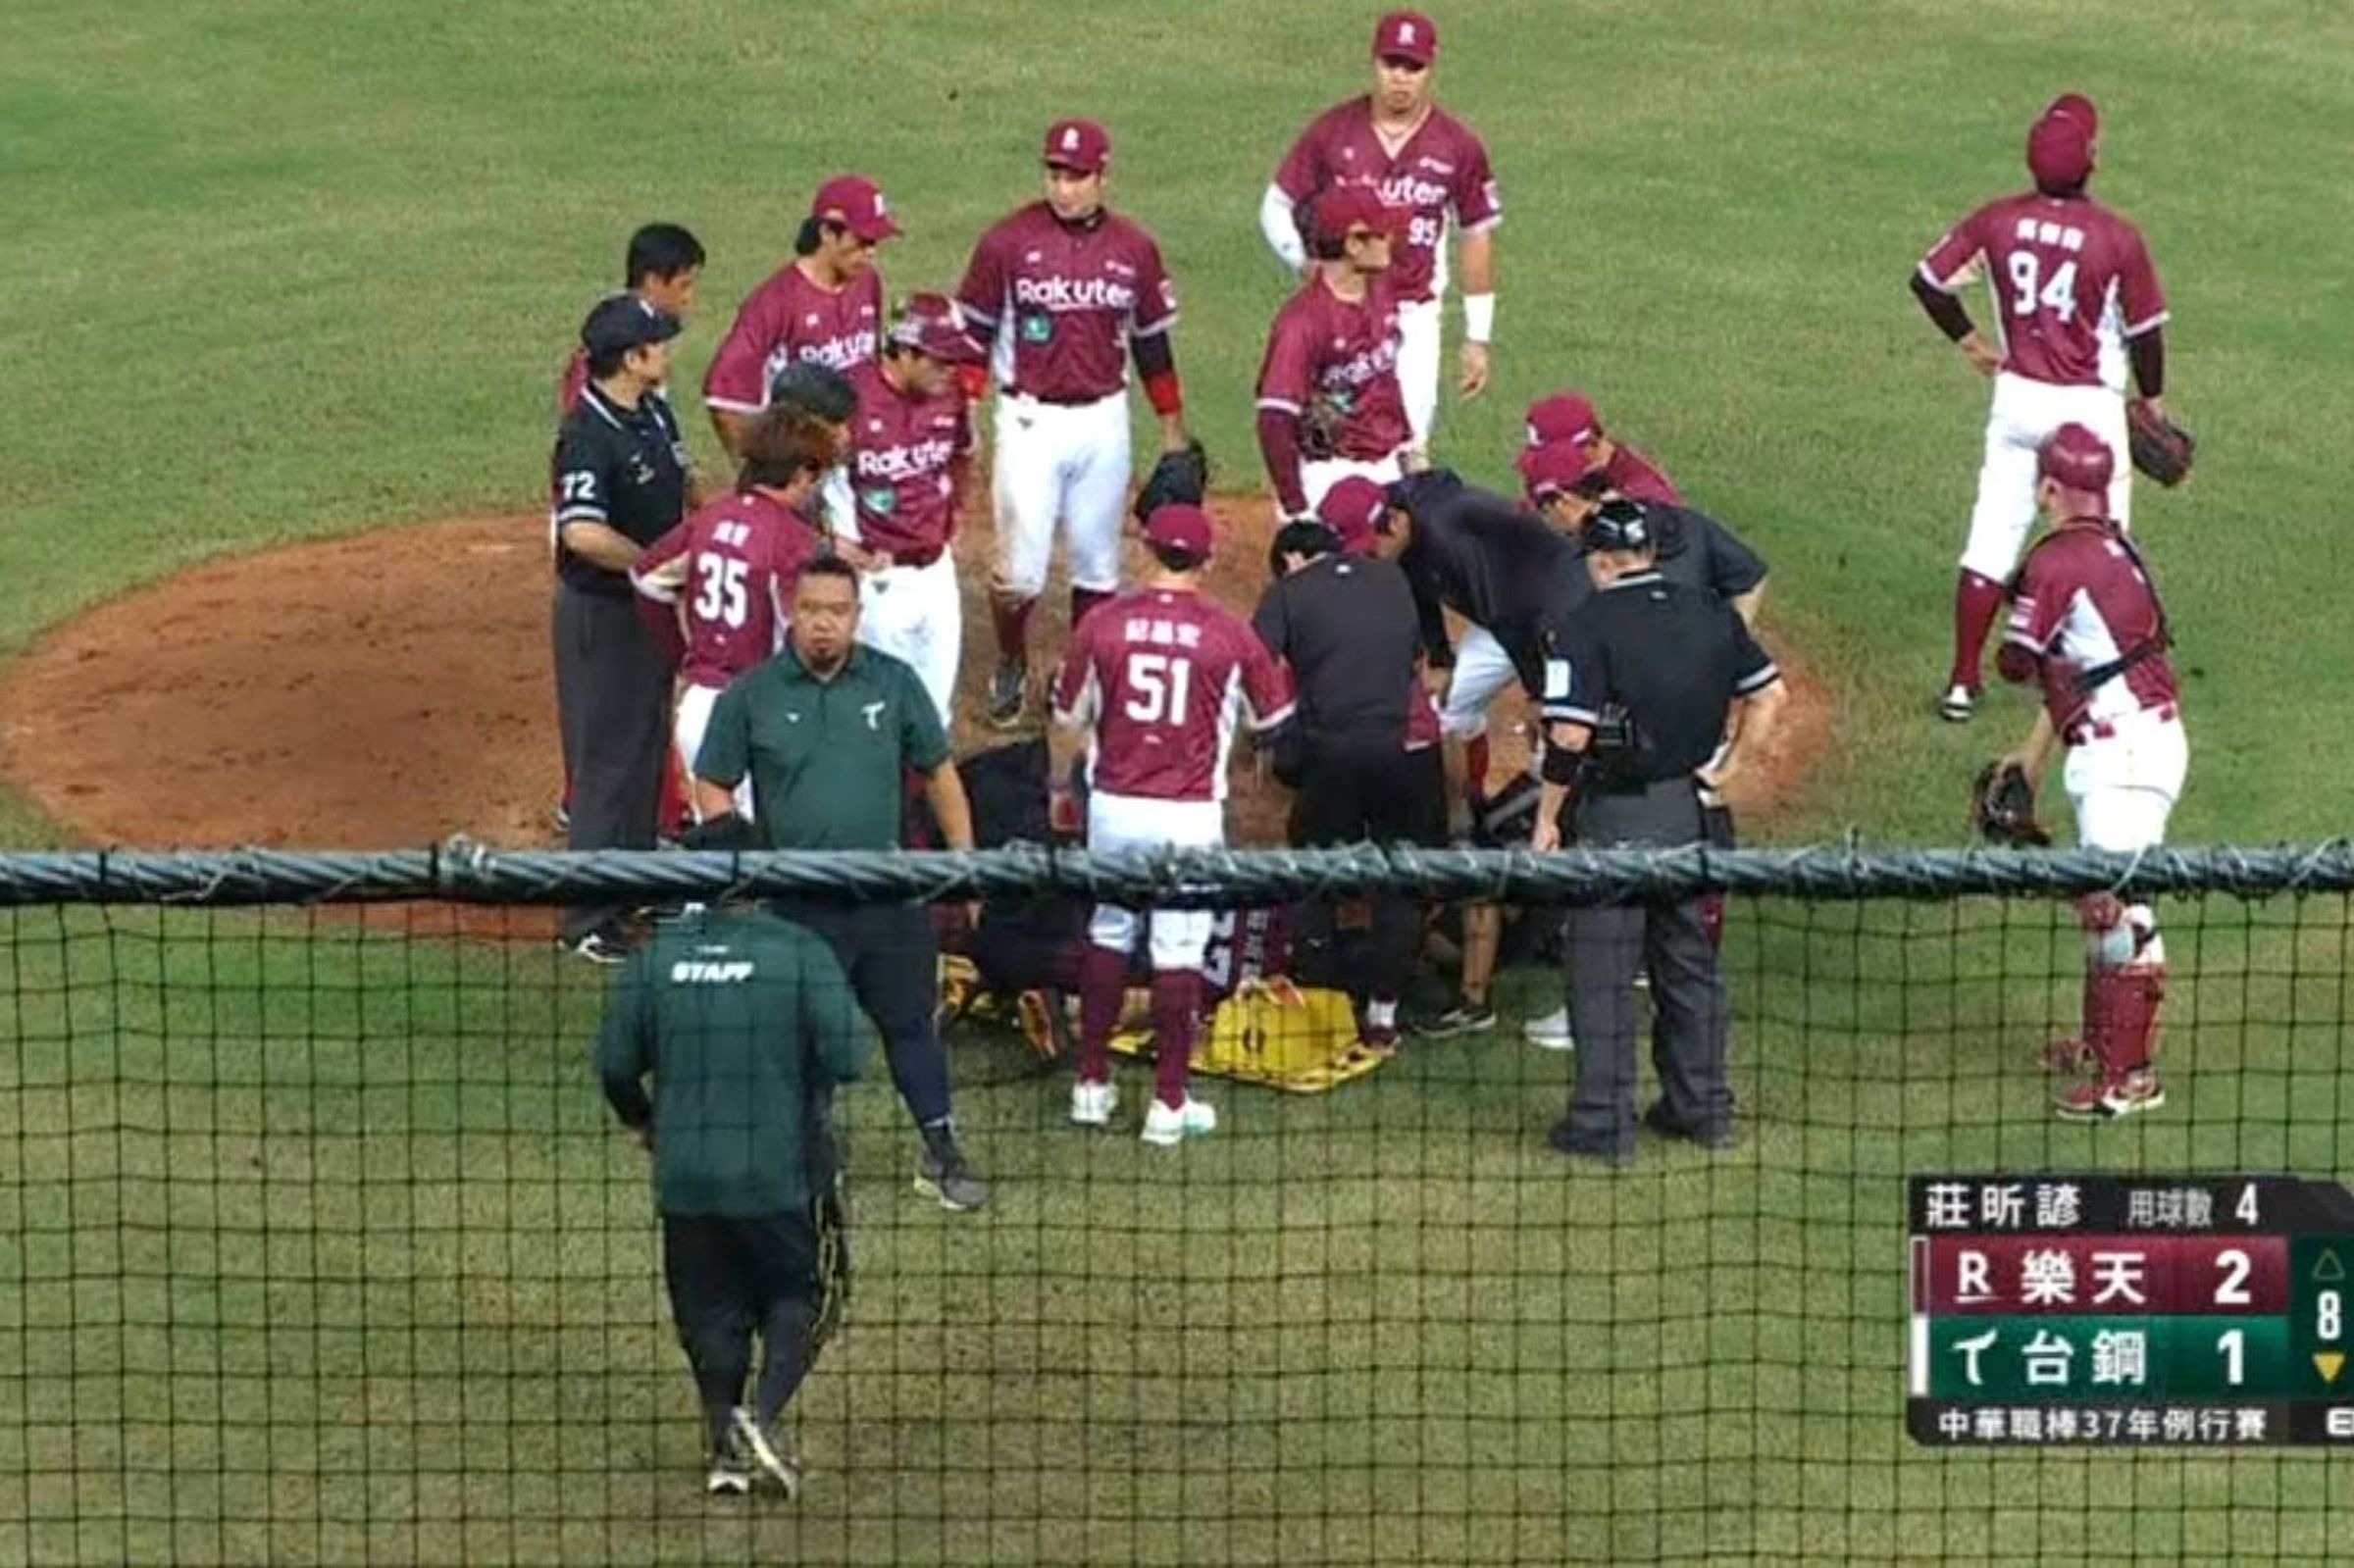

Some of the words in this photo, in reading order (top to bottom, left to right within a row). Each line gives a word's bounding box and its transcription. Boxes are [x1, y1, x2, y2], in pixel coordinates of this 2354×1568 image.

[2008, 251, 2077, 323] 94
[694, 551, 748, 630] 35
[1124, 652, 1191, 727] 51
[671, 961, 754, 983] STAFF
